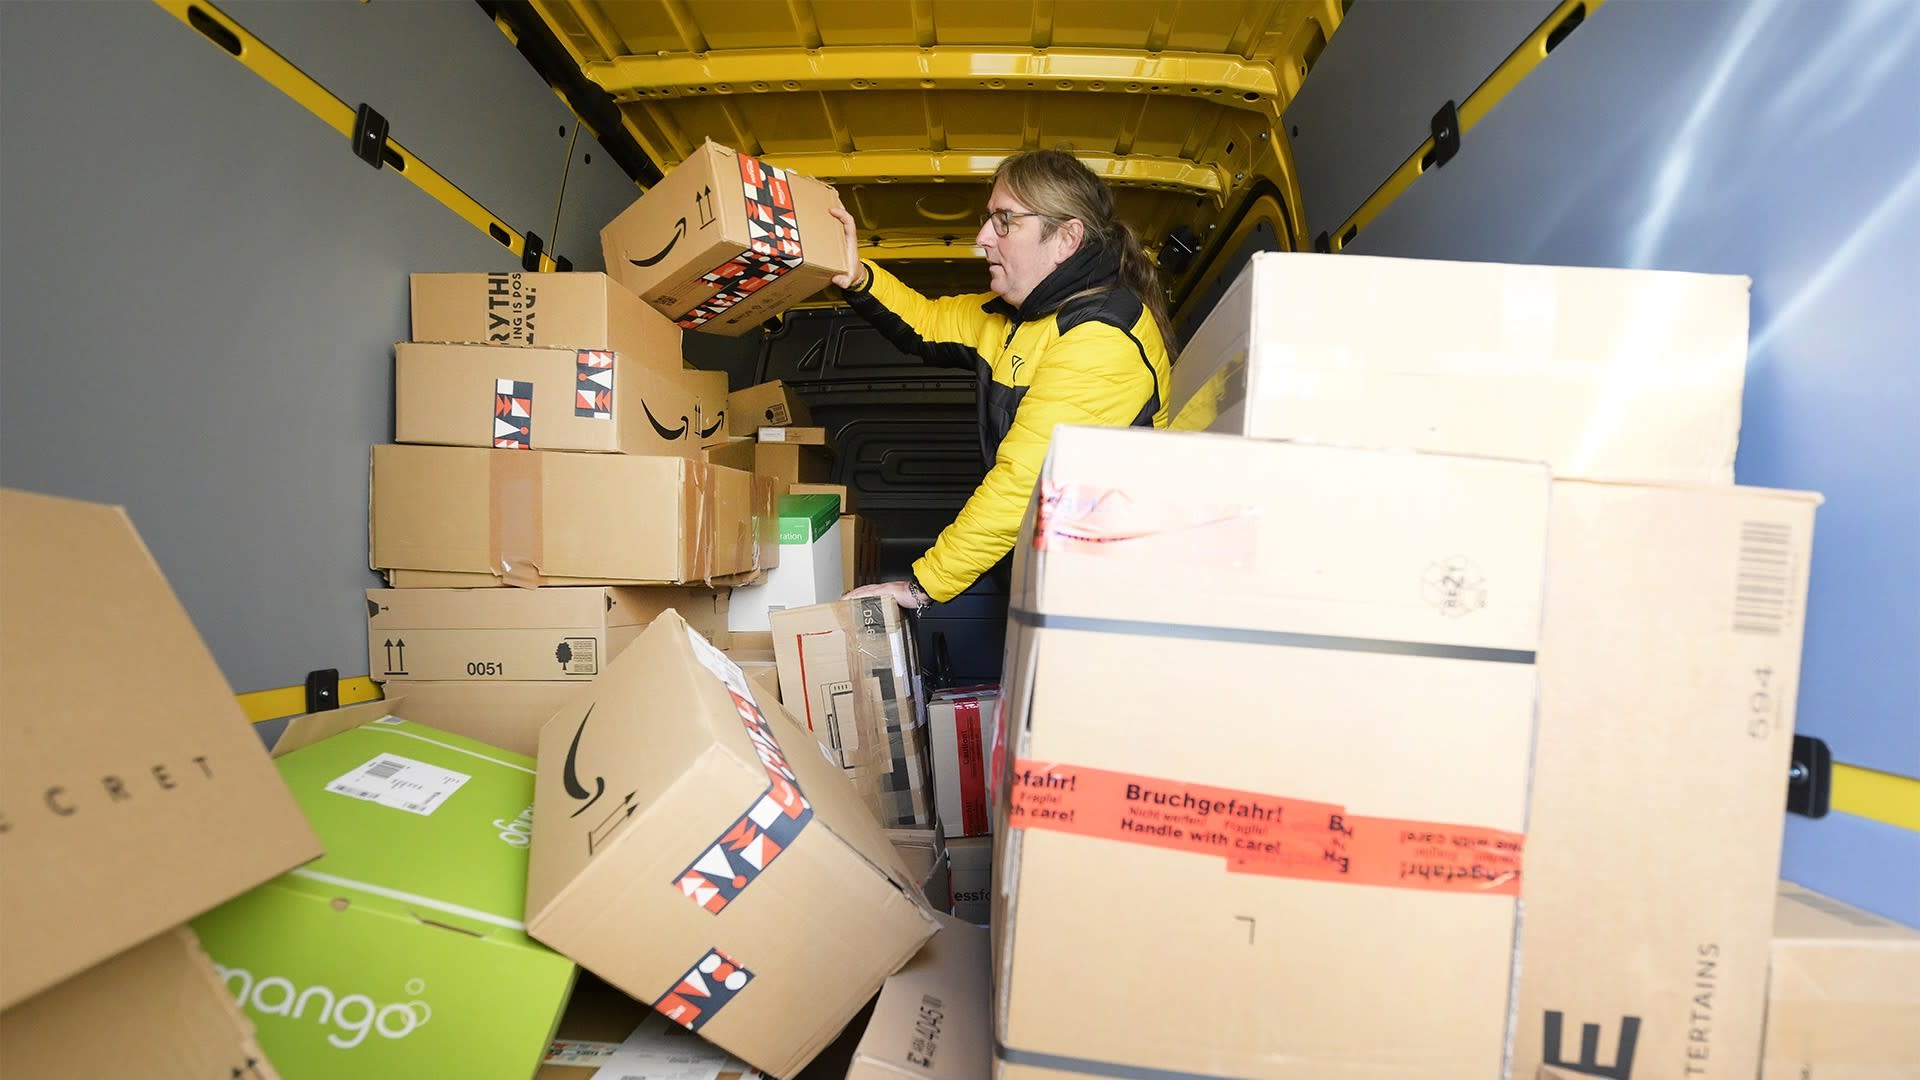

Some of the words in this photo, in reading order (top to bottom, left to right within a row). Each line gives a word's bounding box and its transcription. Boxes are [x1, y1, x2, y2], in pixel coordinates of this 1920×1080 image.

[512, 273, 522, 297] POS
[513, 302, 522, 313] IS
[513, 318, 522, 339] ING
[466, 661, 504, 676] 0051
[1126, 783, 1284, 823] Bruchgefahr!
[1031, 808, 1075, 823] care!
[1120, 818, 1183, 839] Handle
[1190, 829, 1229, 847] with
[1235, 836, 1281, 856] care!
[1684, 941, 1721, 1078] TERTAINS
